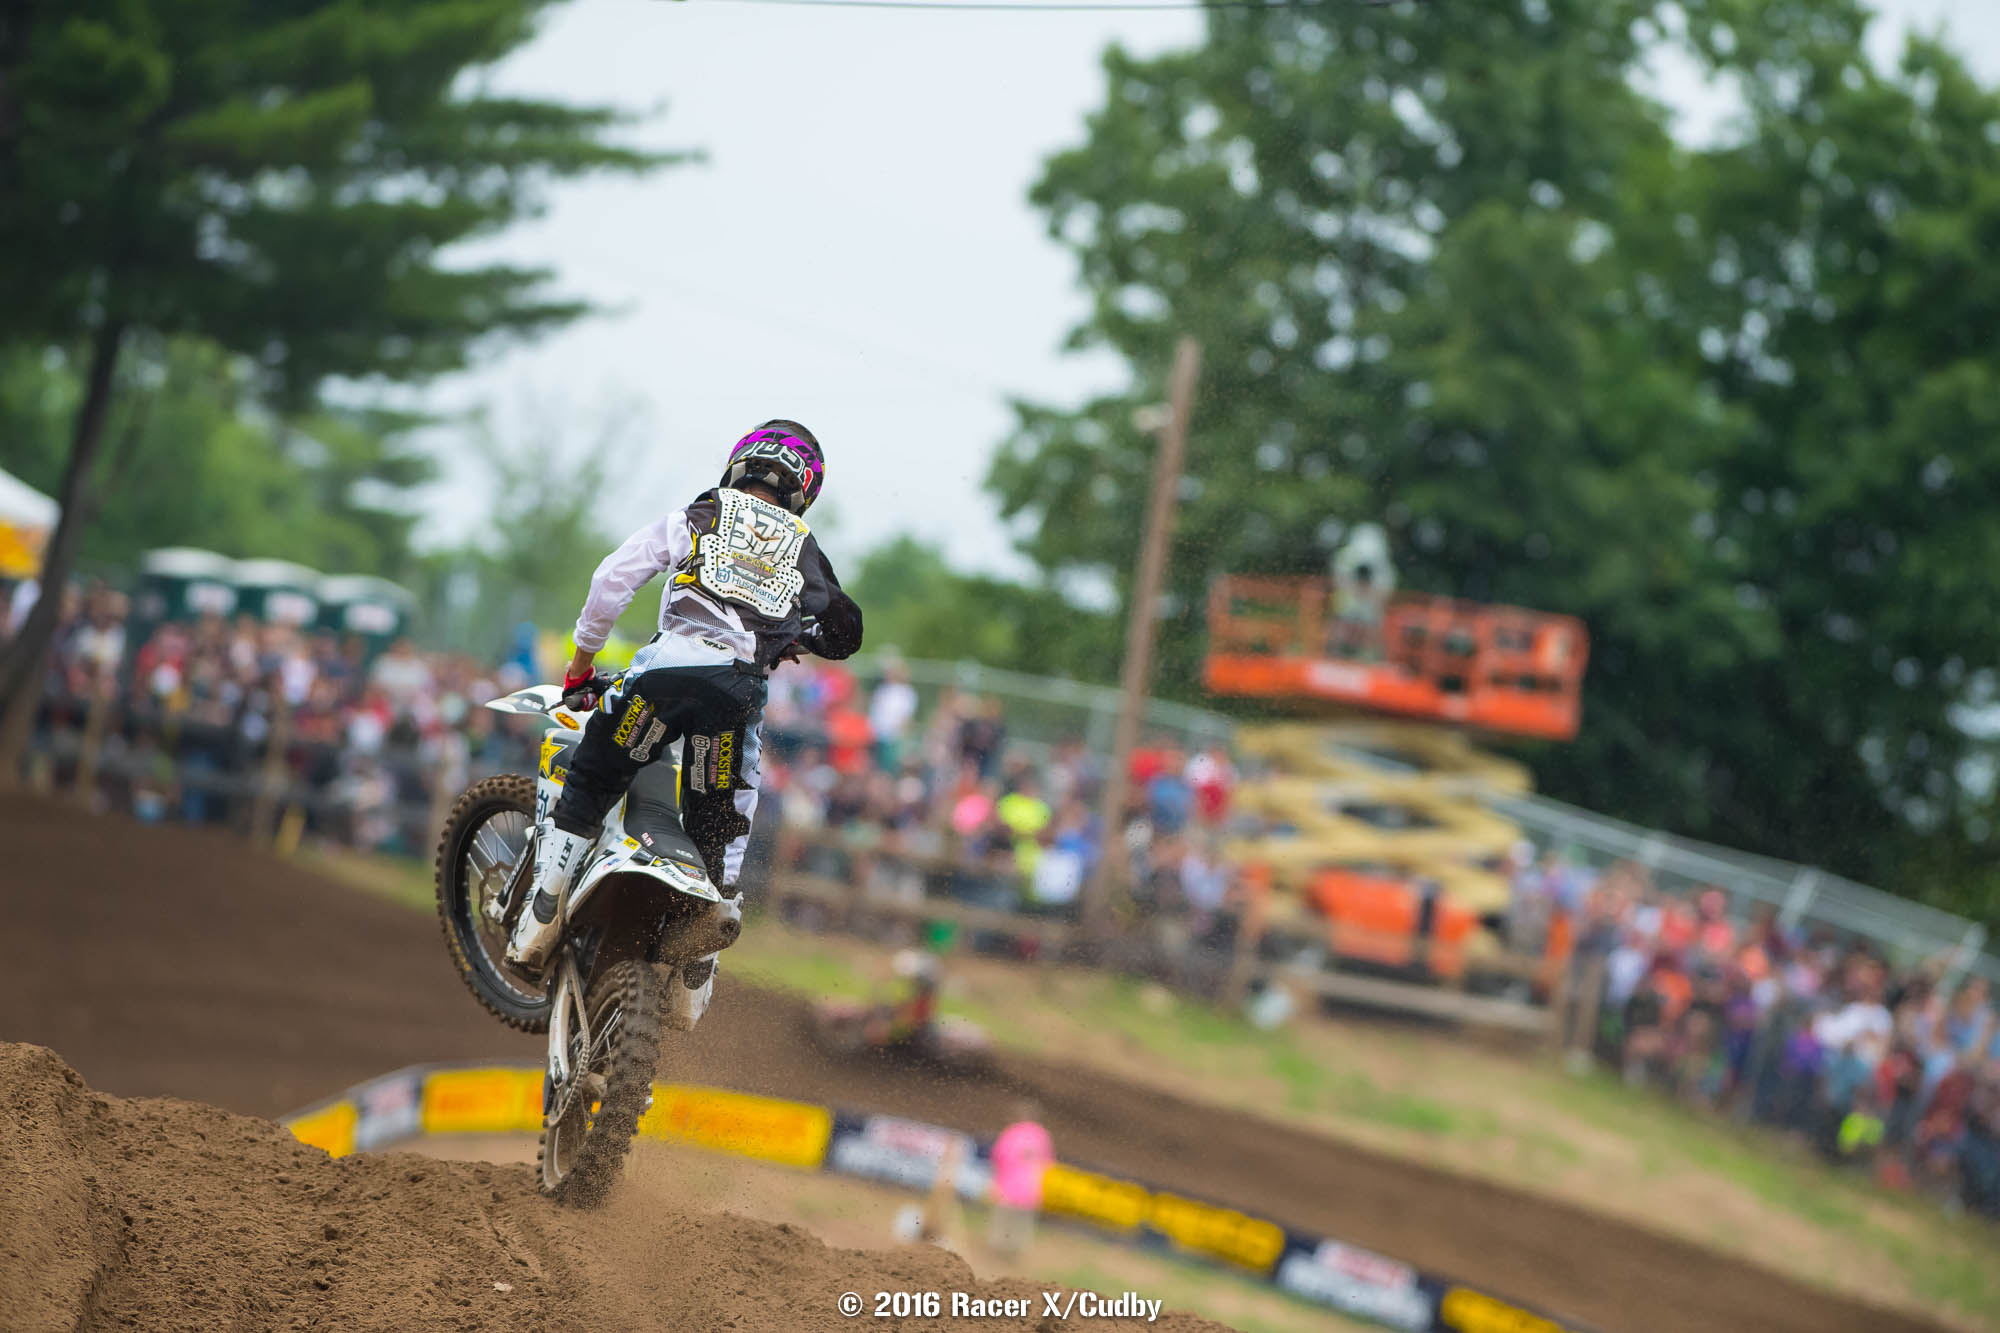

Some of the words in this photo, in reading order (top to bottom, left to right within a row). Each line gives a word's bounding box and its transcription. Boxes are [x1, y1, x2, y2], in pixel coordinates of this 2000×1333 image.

[731, 551, 777, 576] ROCKSTAR
[732, 575, 778, 603] Husqvarna
[614, 696, 646, 747] ROCKSTAR
[717, 732, 733, 789] ROCKSTAR
[558, 837, 574, 872] JETT
